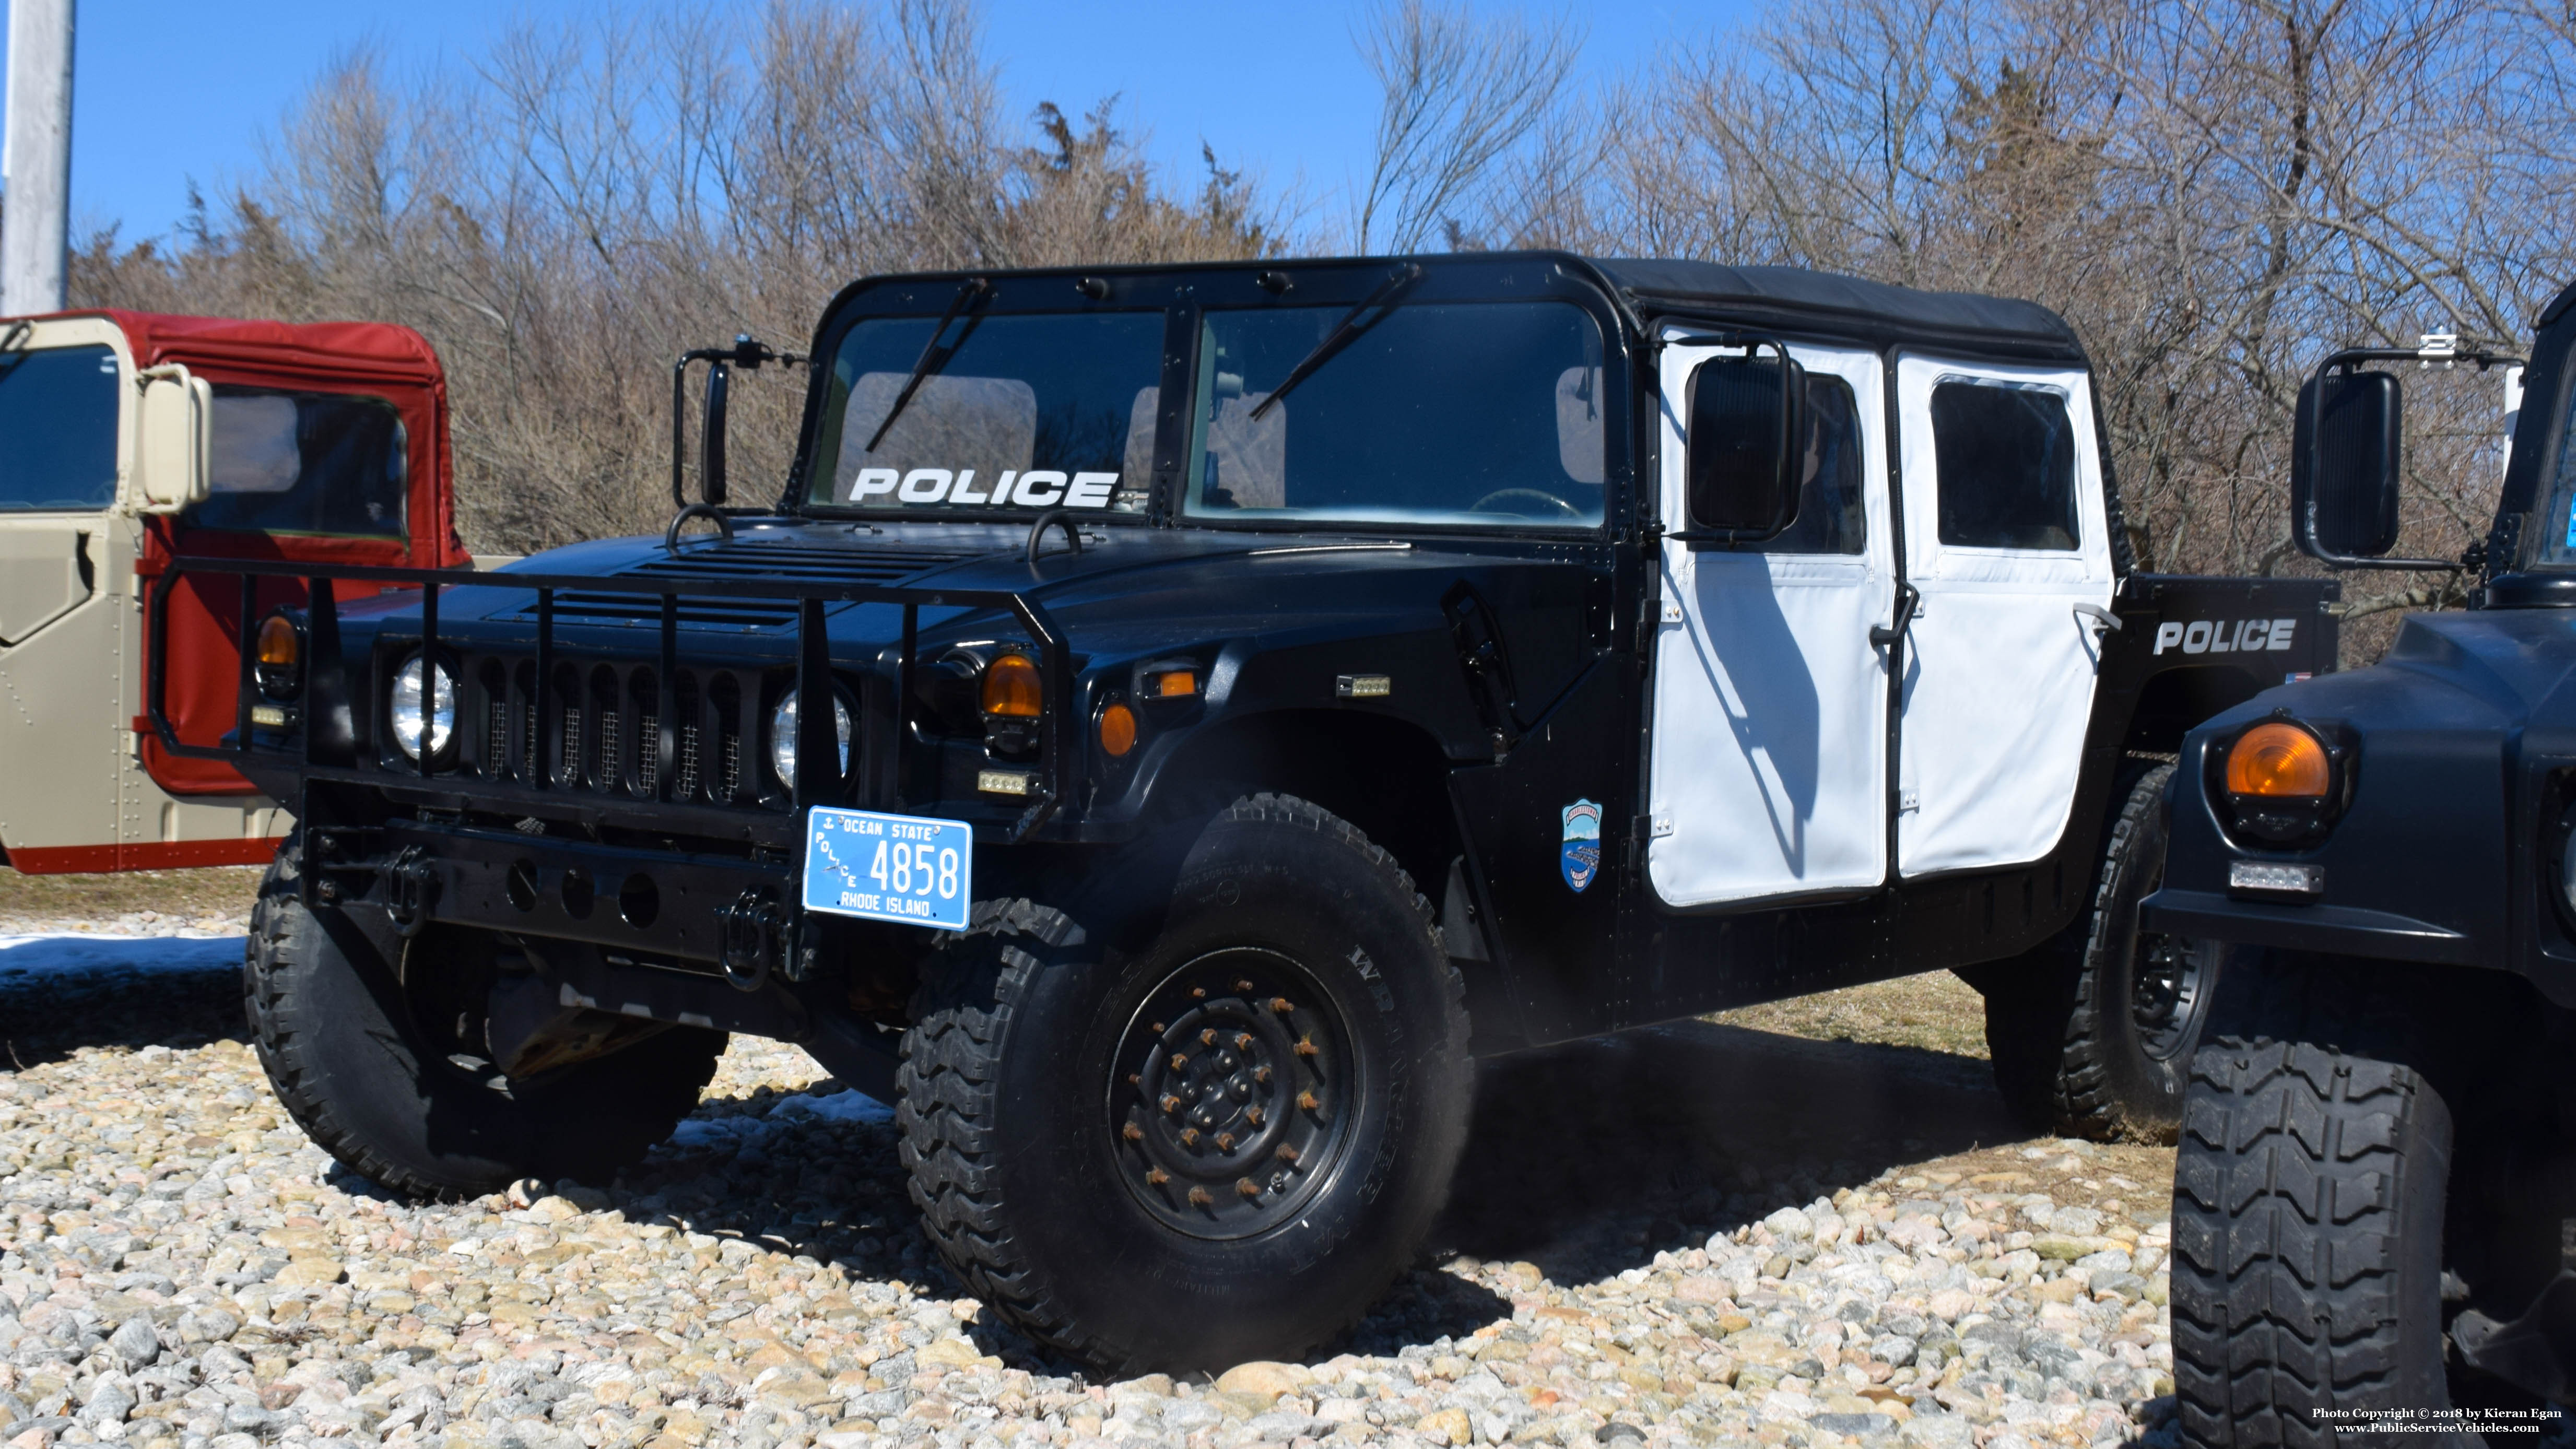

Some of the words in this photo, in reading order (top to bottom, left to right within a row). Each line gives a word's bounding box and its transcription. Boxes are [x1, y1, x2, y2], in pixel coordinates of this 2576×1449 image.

[849, 468, 1119, 507] POLICE
[2152, 619, 2296, 655] POLICE
[843, 819, 883, 835] OCEAN
[892, 824, 932, 842] STATE
[815, 832, 856, 888] POLICE
[870, 840, 958, 899] 4858
[841, 891, 880, 911] RHODE
[887, 897, 929, 917] ISLAND
